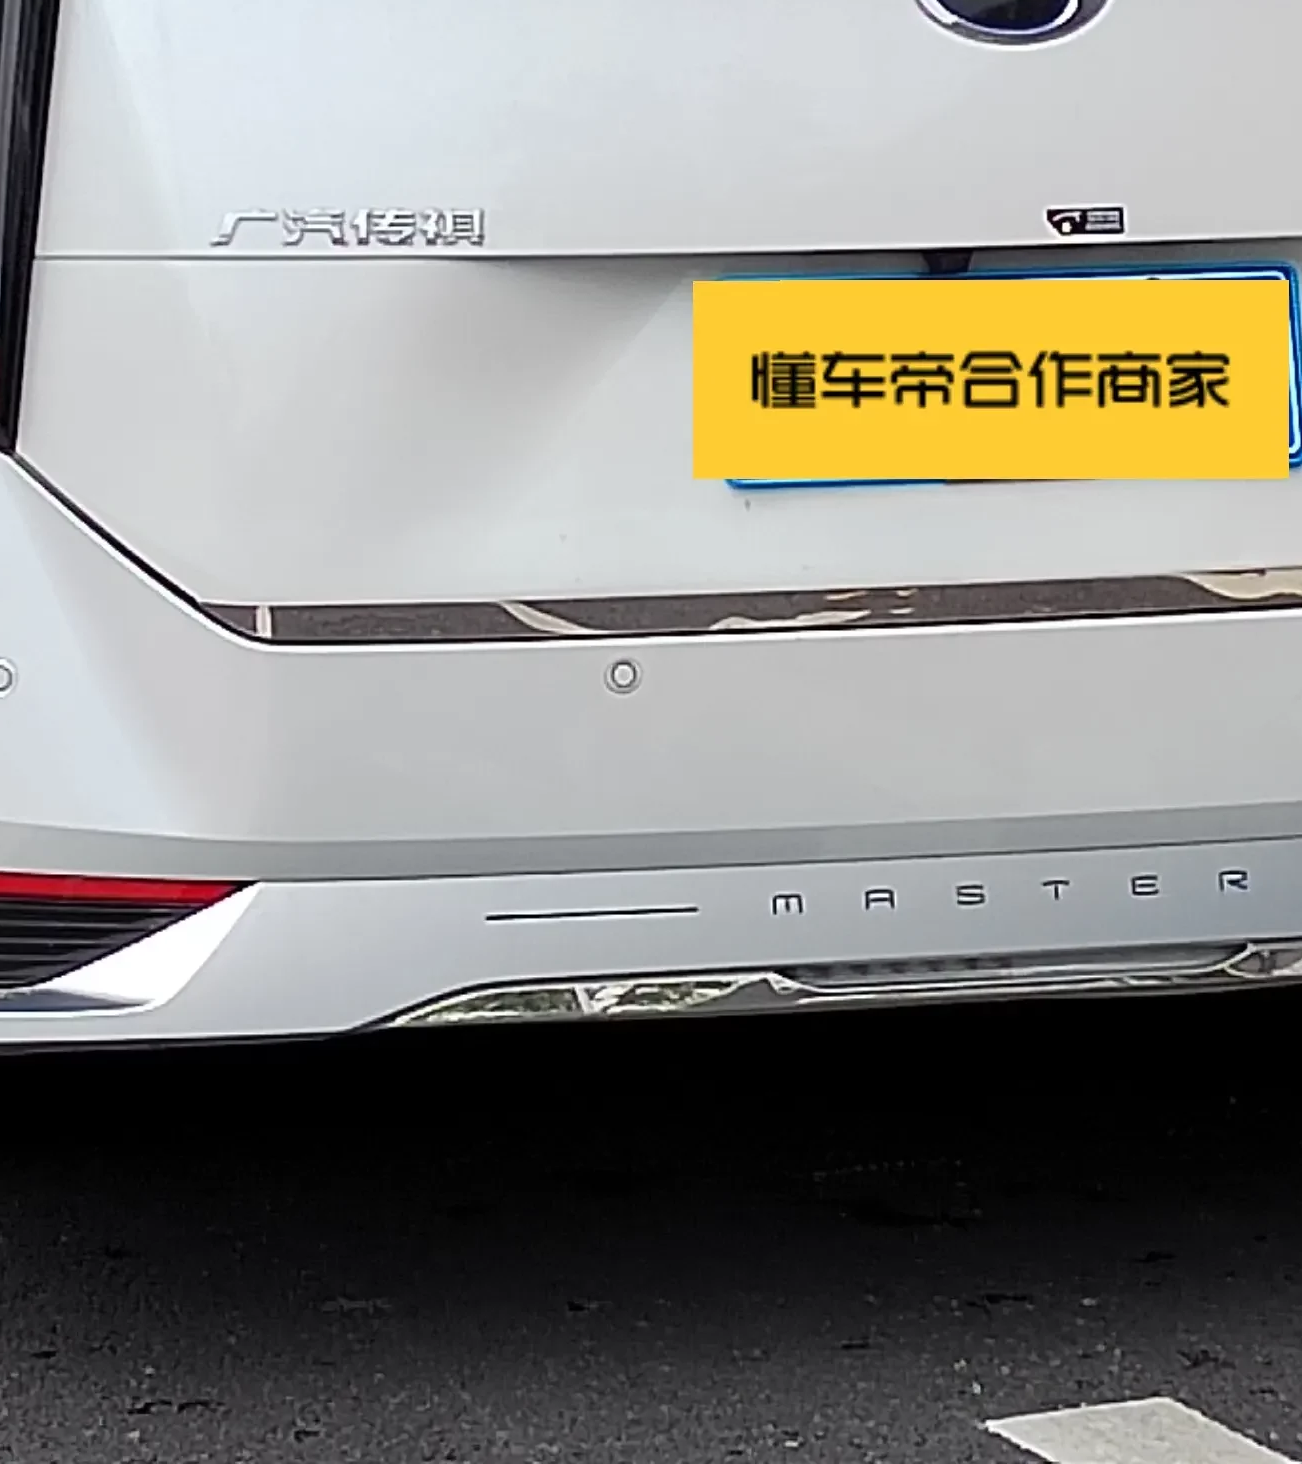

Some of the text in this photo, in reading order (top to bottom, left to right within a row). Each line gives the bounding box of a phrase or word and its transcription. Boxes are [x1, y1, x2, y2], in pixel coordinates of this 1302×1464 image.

[210, 207, 485, 247] 广汽传祺
[772, 868, 1249, 916] MASTER
